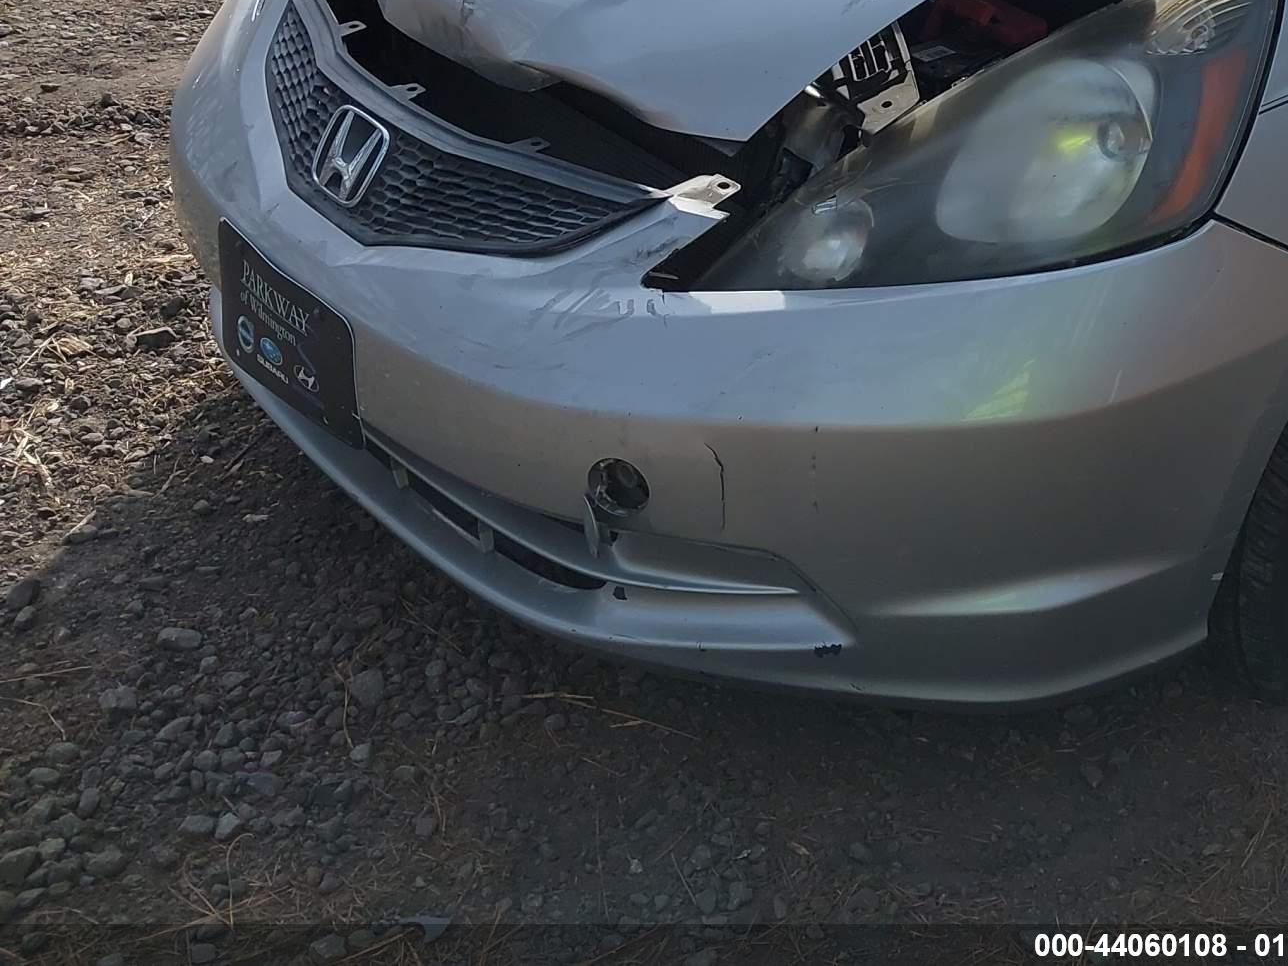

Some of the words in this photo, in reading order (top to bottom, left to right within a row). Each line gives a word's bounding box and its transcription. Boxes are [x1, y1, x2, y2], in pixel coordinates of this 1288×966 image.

[240, 290, 250, 305] of
[241, 259, 309, 334] PARKWAY
[257, 353, 289, 385] SUBARU
